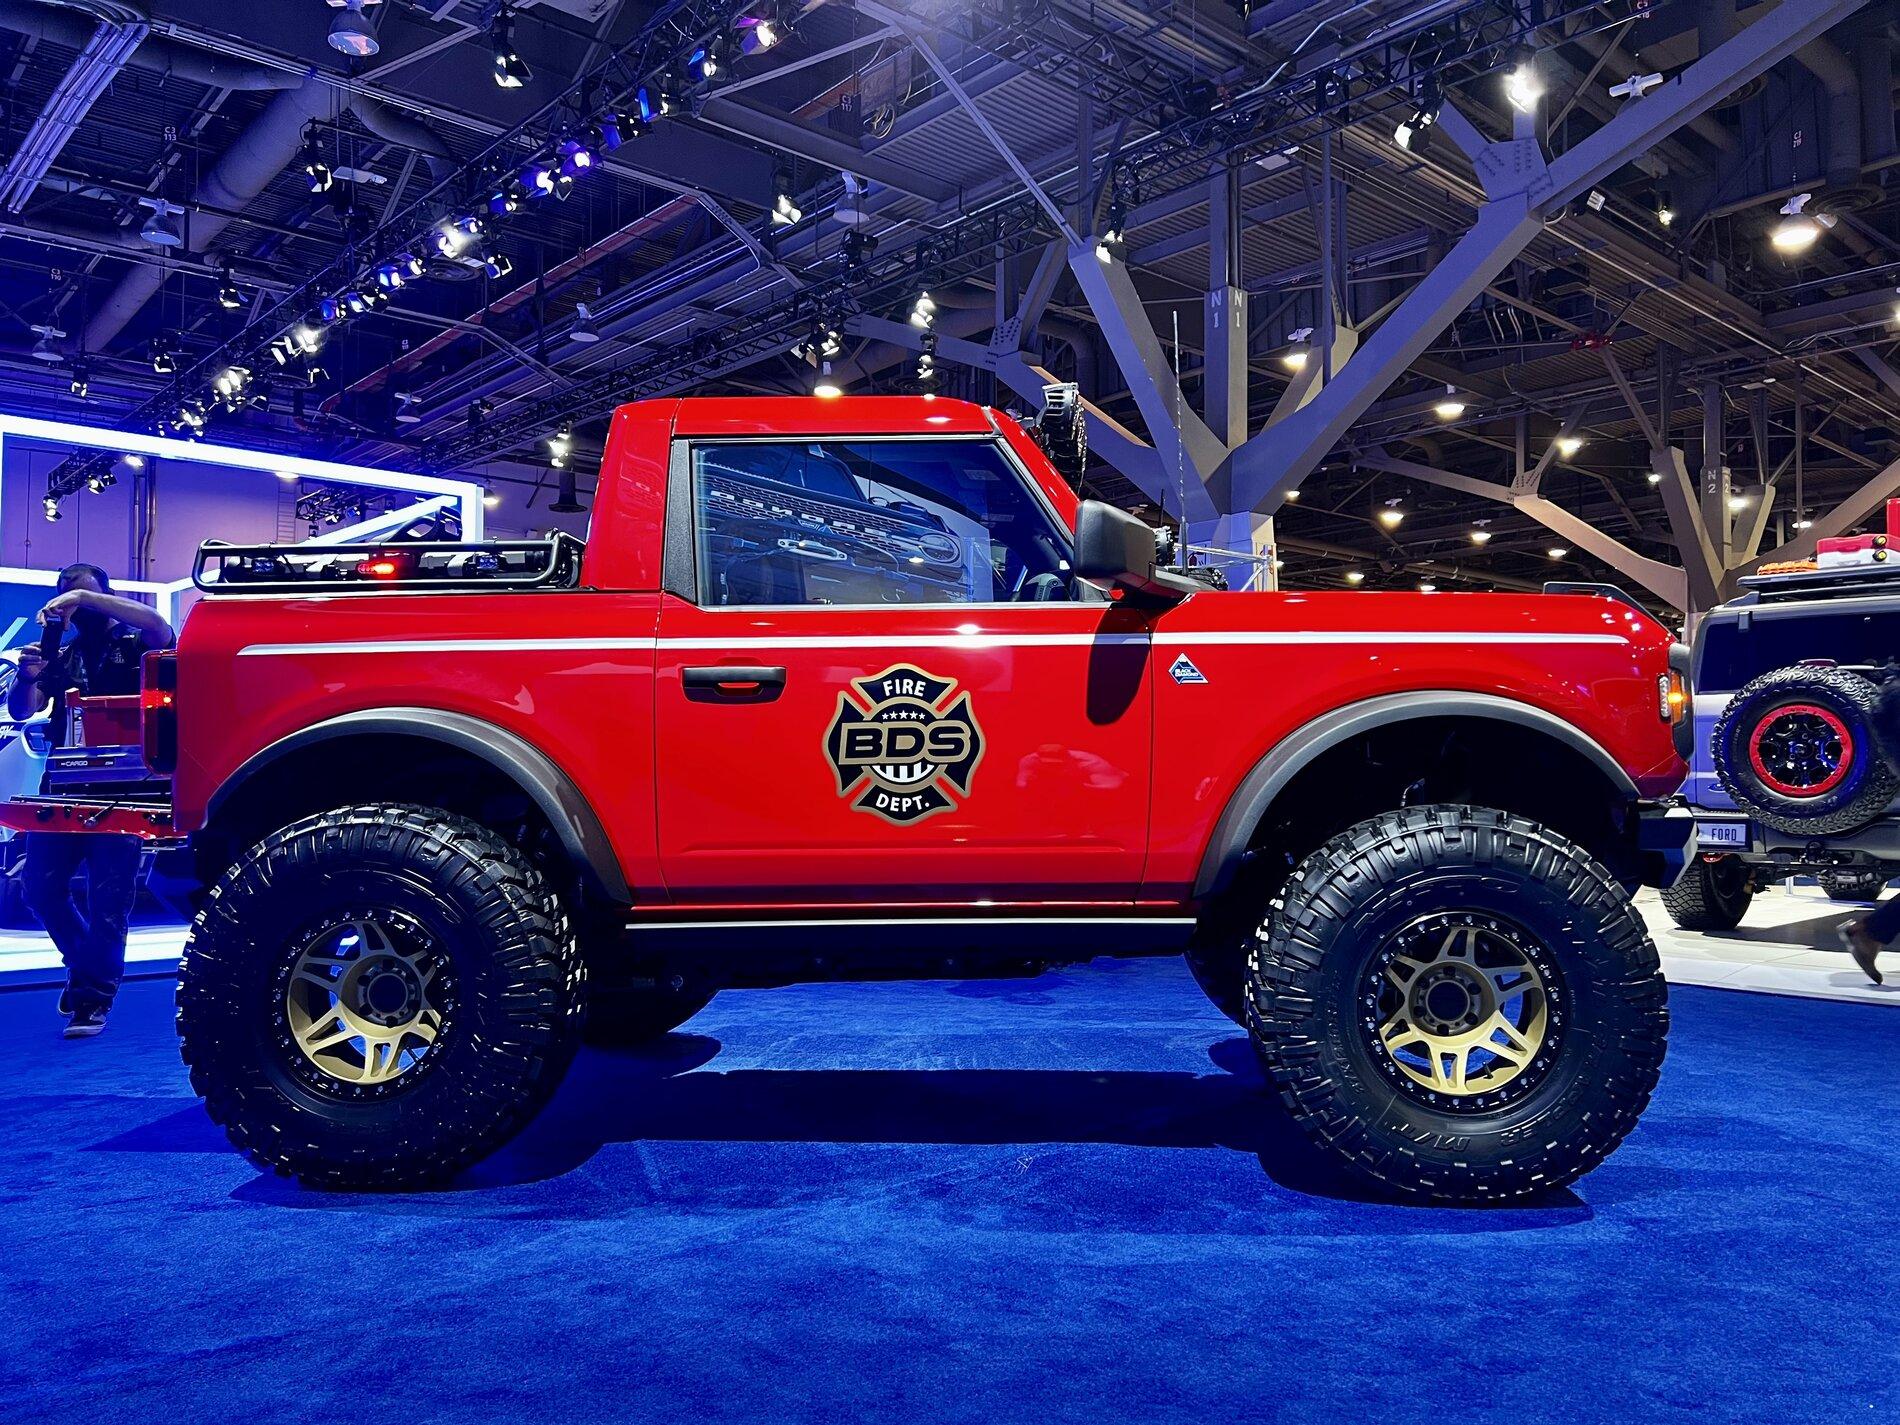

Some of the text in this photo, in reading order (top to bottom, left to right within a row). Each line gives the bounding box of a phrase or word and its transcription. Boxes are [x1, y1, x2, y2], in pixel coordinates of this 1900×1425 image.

[163, 133, 177, 141] 113
[164, 126, 176, 134] C3
[1211, 290, 1222, 308] N
[1234, 289, 1243, 308] N
[1213, 312, 1219, 328] 1
[1236, 311, 1240, 328] 1
[1707, 469, 1716, 480] N
[1708, 483, 1716, 494] 2
[883, 679, 926, 697] FIRE
[841, 721, 969, 763] BDS
[875, 792, 930, 812] DEPT.
[1711, 828, 1737, 841] FORD
